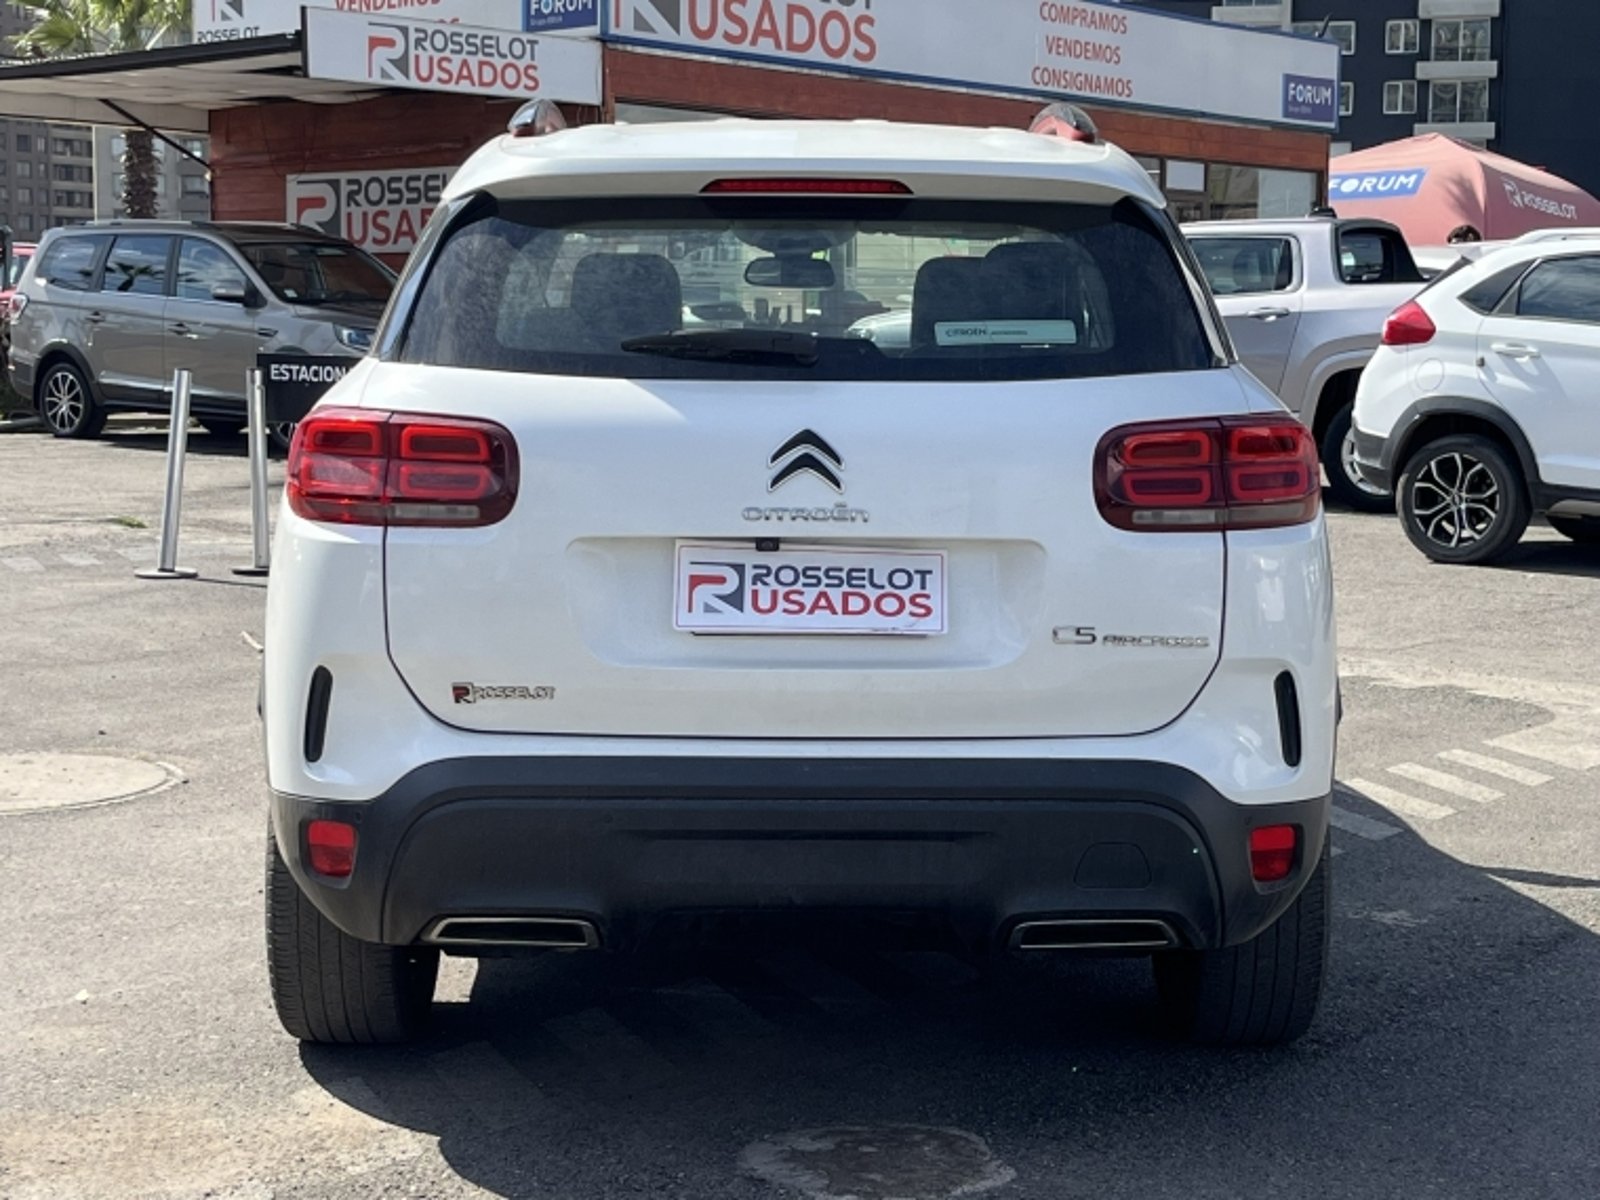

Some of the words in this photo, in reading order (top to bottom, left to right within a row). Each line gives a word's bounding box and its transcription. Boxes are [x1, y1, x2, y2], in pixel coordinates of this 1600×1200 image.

[690, 0, 877, 62] USADOS
[1039, 1, 1128, 35] COMPRAMOS
[413, 26, 540, 62] ROSSELOT
[1045, 35, 1121, 66] VENDEMOS
[413, 53, 540, 92] USADOS
[1031, 66, 1134, 98] CONSIGNAMOS
[1287, 82, 1332, 107] FORUM
[1329, 172, 1418, 194] FORUM
[270, 363, 347, 383] ESTACION
[751, 564, 934, 591] ROSSELOT
[751, 588, 934, 619] USADOS
[1052, 626, 1097, 645] C5
[1102, 634, 1210, 648] AIRCROSS
